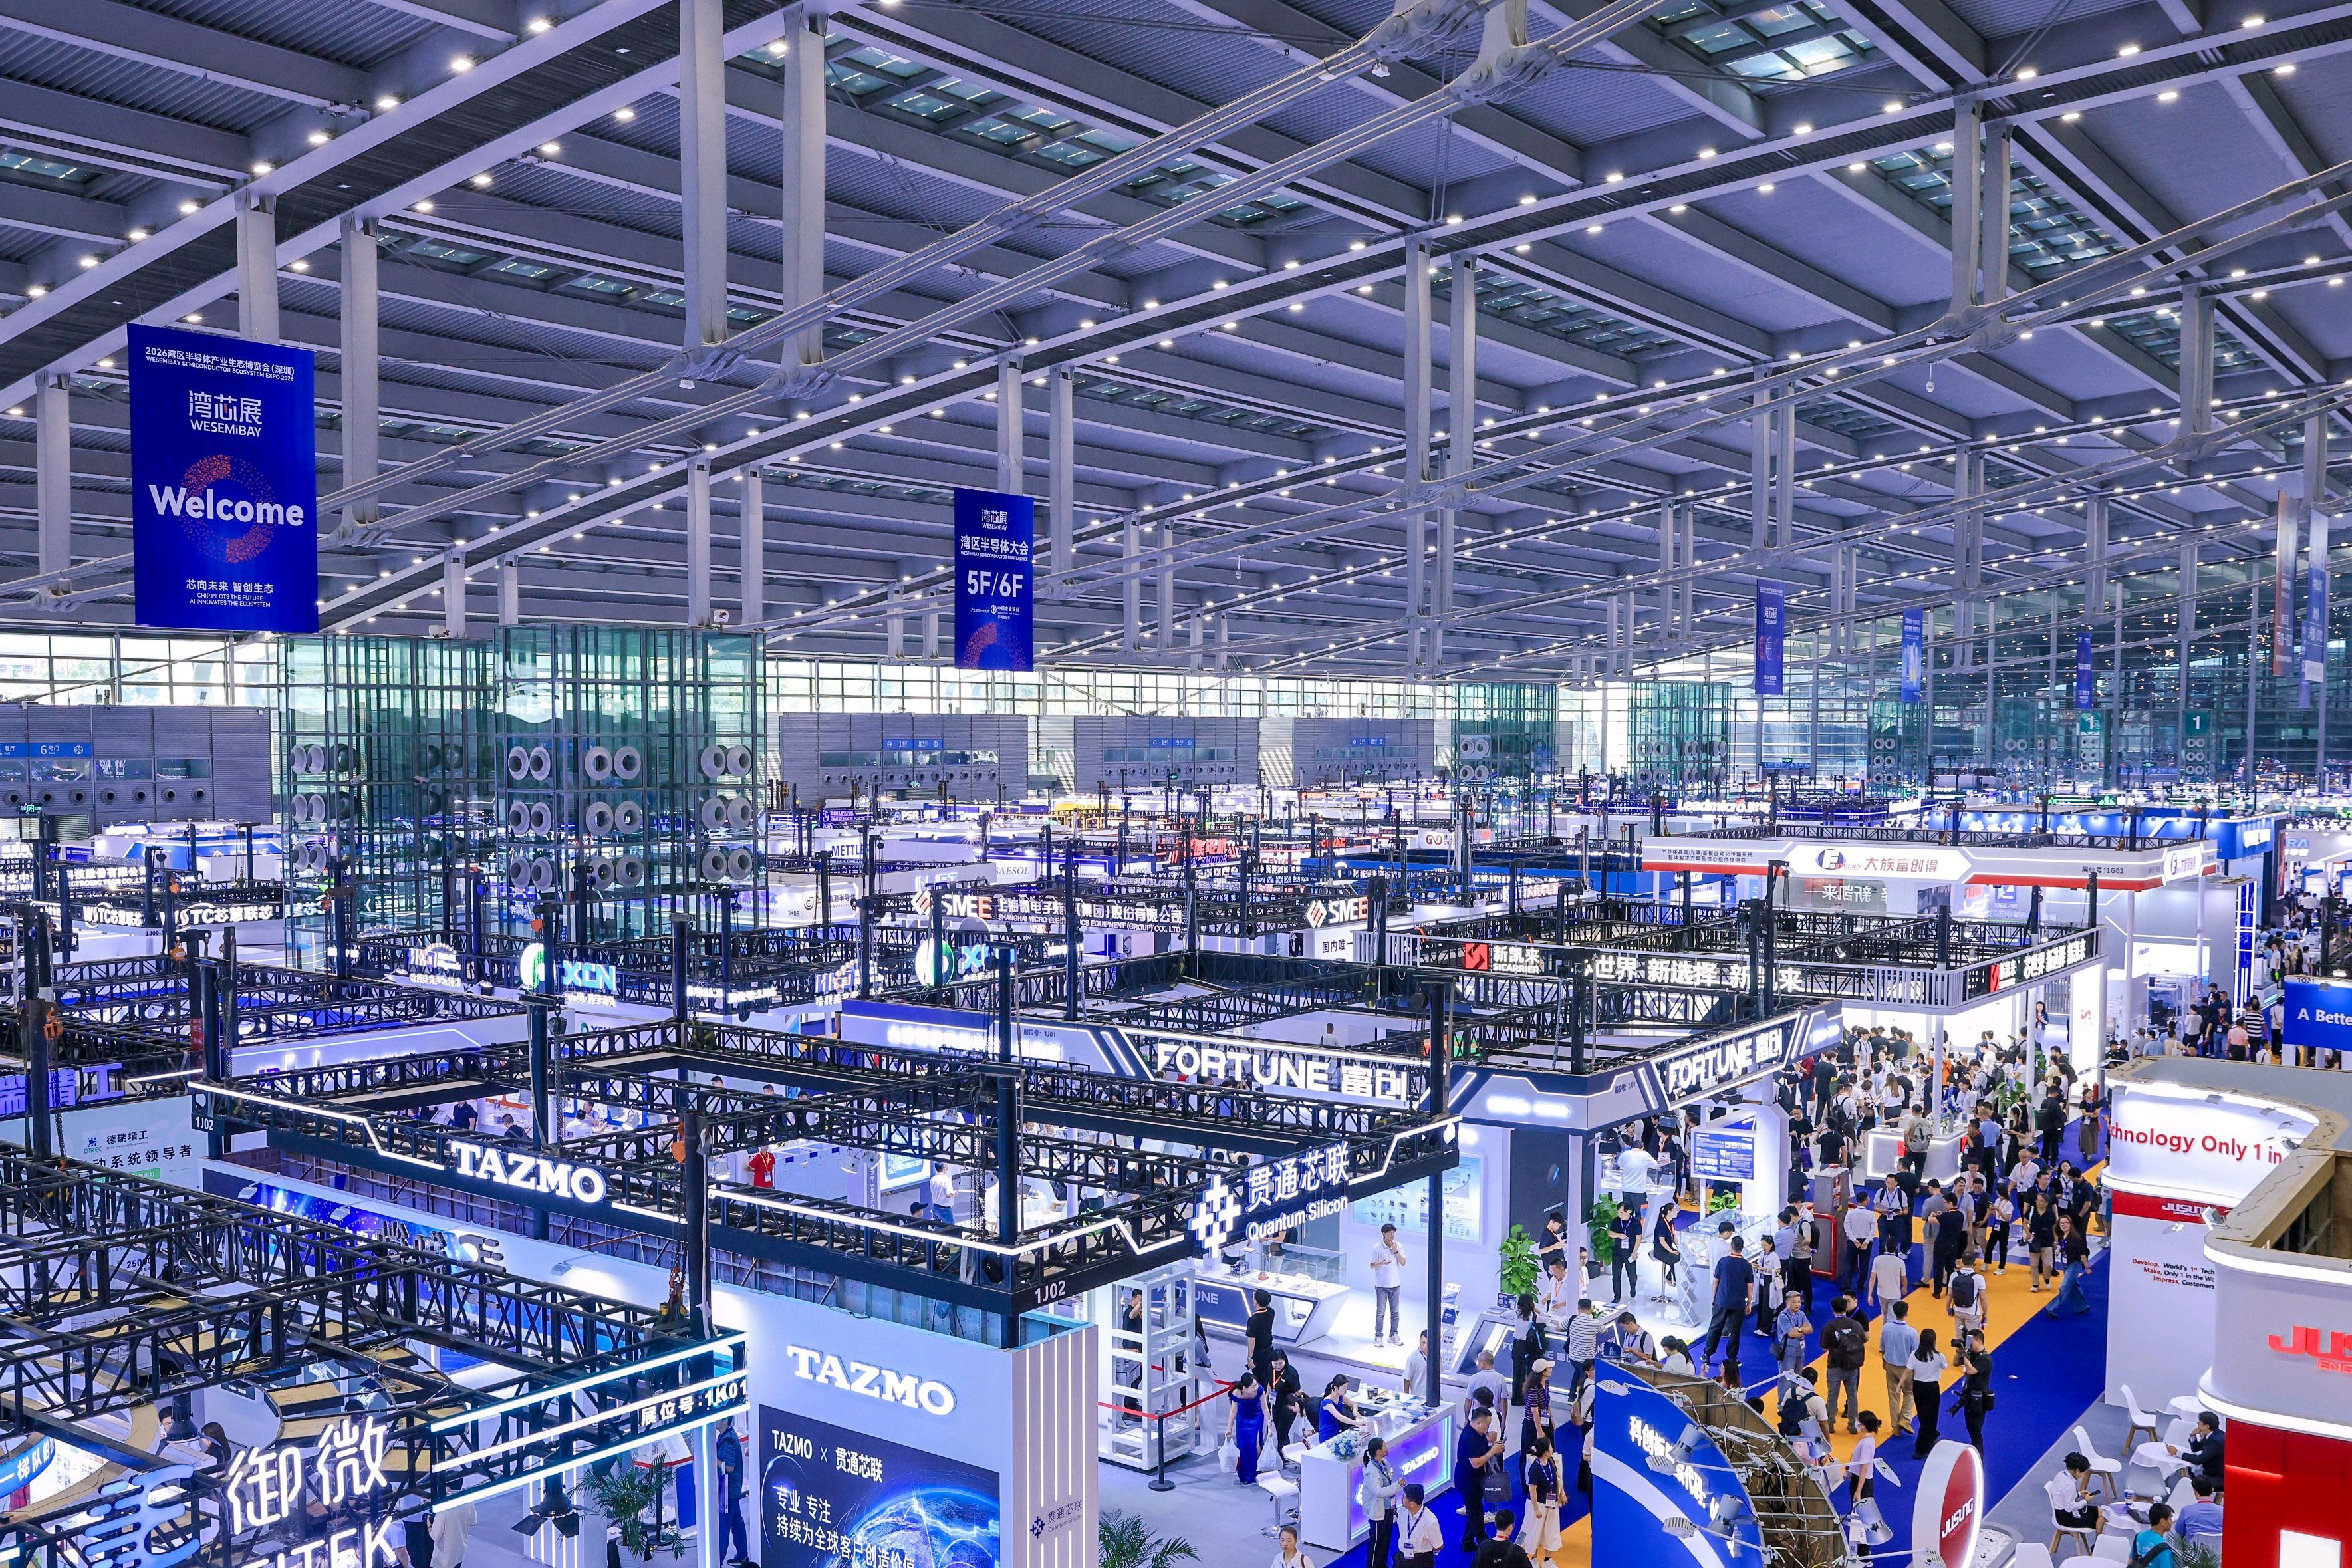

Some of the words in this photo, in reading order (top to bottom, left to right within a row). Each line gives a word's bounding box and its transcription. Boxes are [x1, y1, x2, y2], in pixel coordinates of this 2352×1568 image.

[182, 360, 231, 373] SEMICONDUCTOR
[232, 368, 265, 378] ECOSYSTEM
[189, 390, 263, 424] 湾芯展
[148, 483, 304, 527] Welcome
[981, 509, 1007, 525] 湾芯展
[960, 535, 1029, 555] 湾区半导体大会
[186, 579, 229, 592] 芯向未来
[233, 581, 273, 594] 智创生态
[967, 569, 1023, 598] 5F/6F
[2087, 716, 2094, 729] 1
[2193, 716, 2200, 729] 1
[832, 843, 864, 856] METTLE
[1864, 856, 1938, 873] 大族富创得
[1329, 896, 1369, 924] SMEE
[1090, 920, 1126, 930] EQUIPMENT
[1127, 923, 1154, 932] (GROUP)
[1322, 940, 1353, 954] 国内唯一
[1493, 946, 1540, 964] 新凯来
[1493, 964, 1540, 974] SICARRIER
[1648, 958, 1718, 987] 新选择
[2297, 1008, 2310, 1021] A
[2315, 1009, 2352, 1026] Bette
[1668, 1036, 1753, 1094] FORTUNE
[1755, 1028, 1783, 1064] 富创
[1158, 1043, 1330, 1091] FORTUNE
[1341, 1065, 1408, 1102] 富创
[196, 1116, 214, 1131] 1J02
[106, 1130, 148, 1145] 德瑞精工
[2202, 1135, 2247, 1161] Only
[2254, 1144, 2261, 1160] 1
[2268, 1146, 2282, 1164] in
[451, 1140, 607, 1203] TAZMO
[1245, 1140, 1351, 1213] 贯通芯联
[1245, 1209, 1306, 1242] Quantum
[1307, 1194, 1349, 1222] Silicon
[2161, 1202, 2204, 1214] JUSUN
[2163, 1262, 2188, 1271] World's
[1034, 1281, 1066, 1305] 1J02
[2182, 1279, 2215, 1289] Customers
[787, 1345, 957, 1416] TAZMO
[771, 1429, 813, 1460] TAZMO
[835, 1446, 883, 1483] 贯通芯联
[1402, 1446, 1439, 1476] TAZMO
[227, 1416, 388, 1535] 御微
[776, 1485, 801, 1515] 专业
[806, 1494, 831, 1524] 专注
[1047, 1498, 1083, 1525] 贯通芯联
[1048, 1520, 1067, 1533] Quantum
[1067, 1514, 1083, 1525] Silicon
